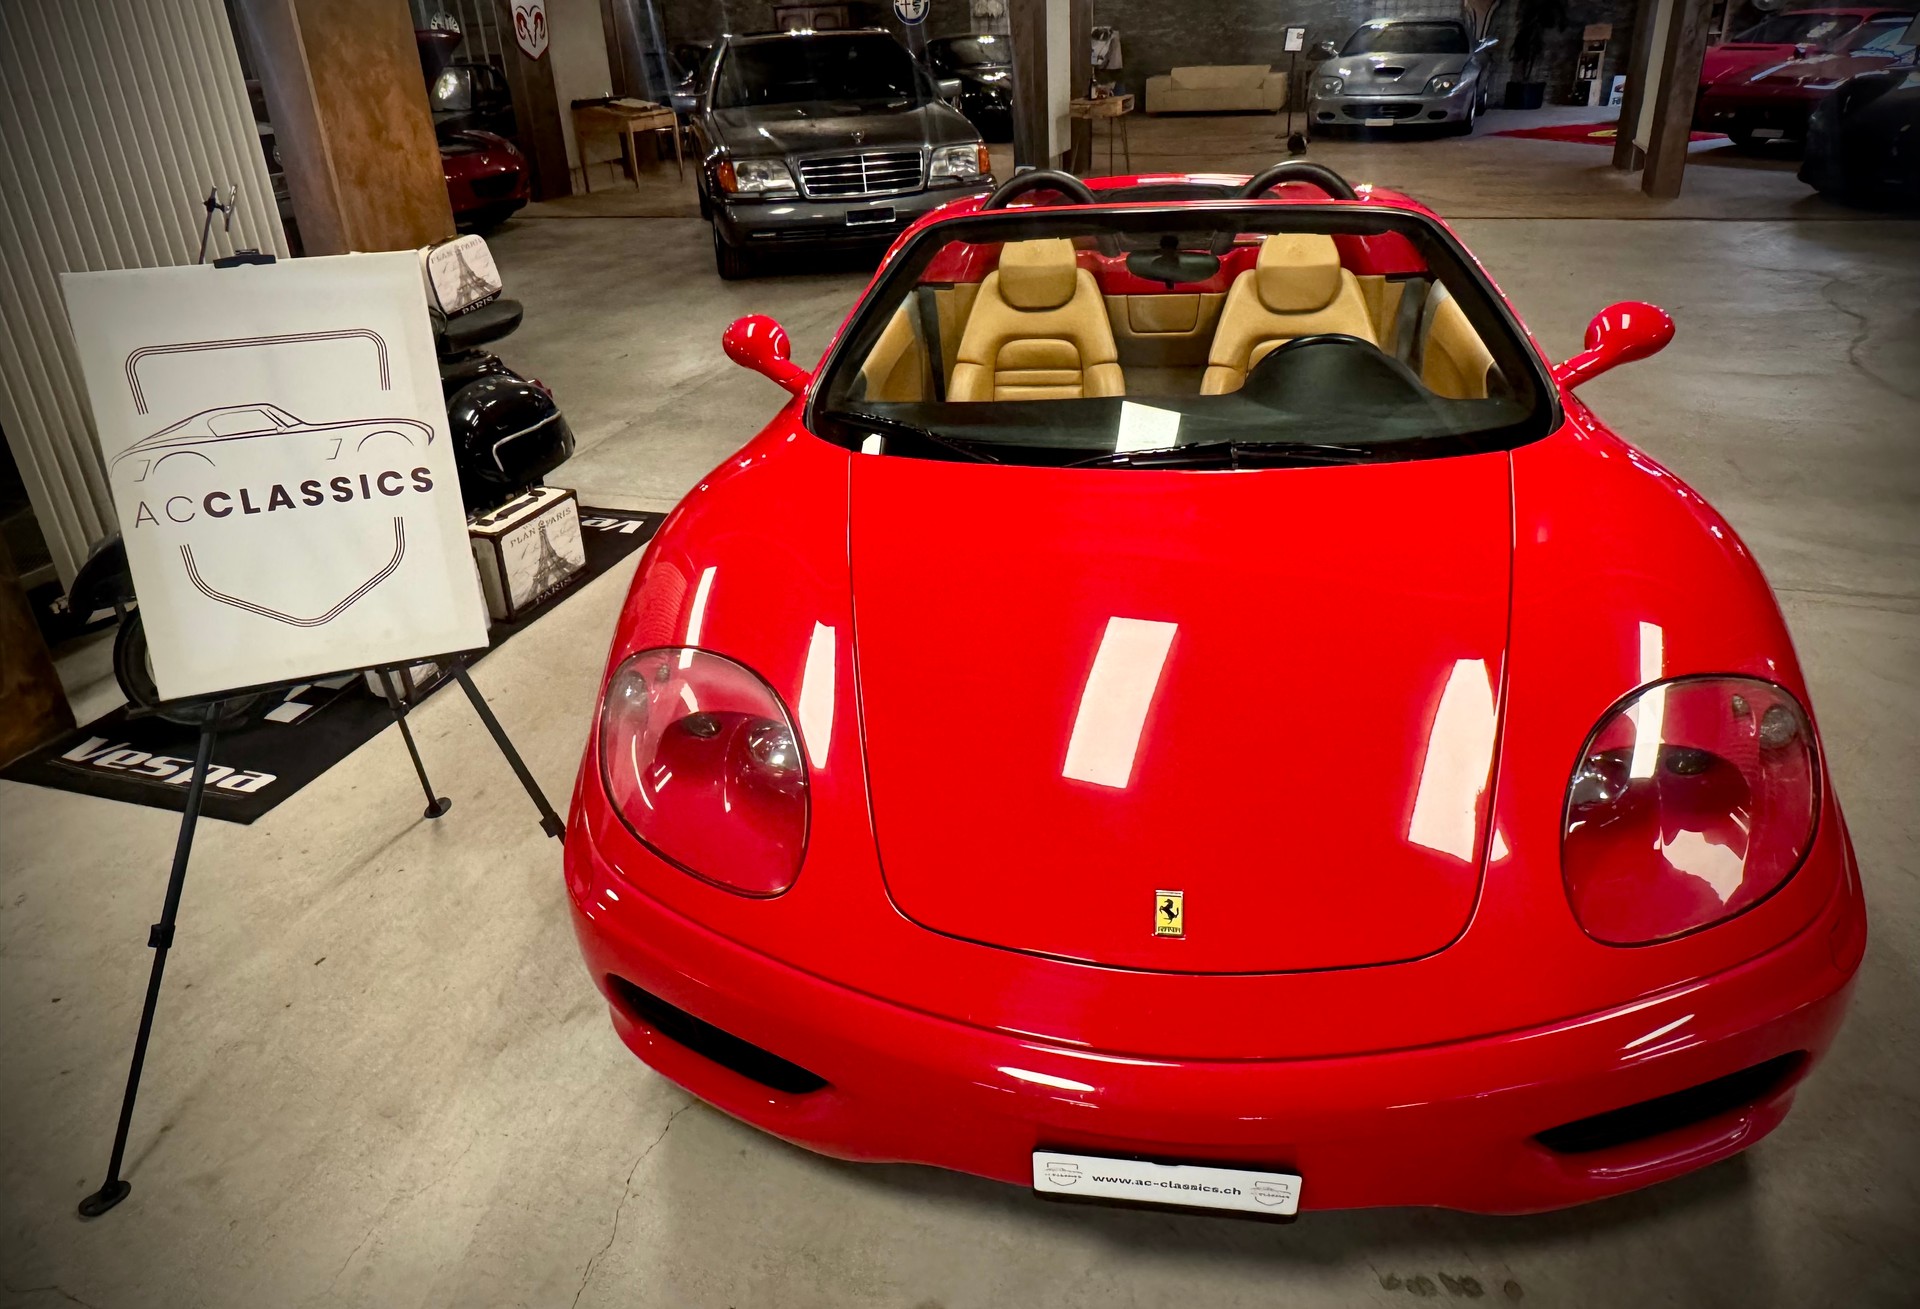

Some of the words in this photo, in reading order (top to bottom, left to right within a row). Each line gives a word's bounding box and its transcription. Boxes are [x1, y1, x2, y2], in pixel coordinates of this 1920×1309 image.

[462, 295, 494, 315] PARIS
[510, 528, 536, 548] PLAN
[545, 507, 572, 527] PARIS
[62, 736, 277, 793] Vespa
[1092, 1175, 1242, 1196] www.ac-classics.ch
